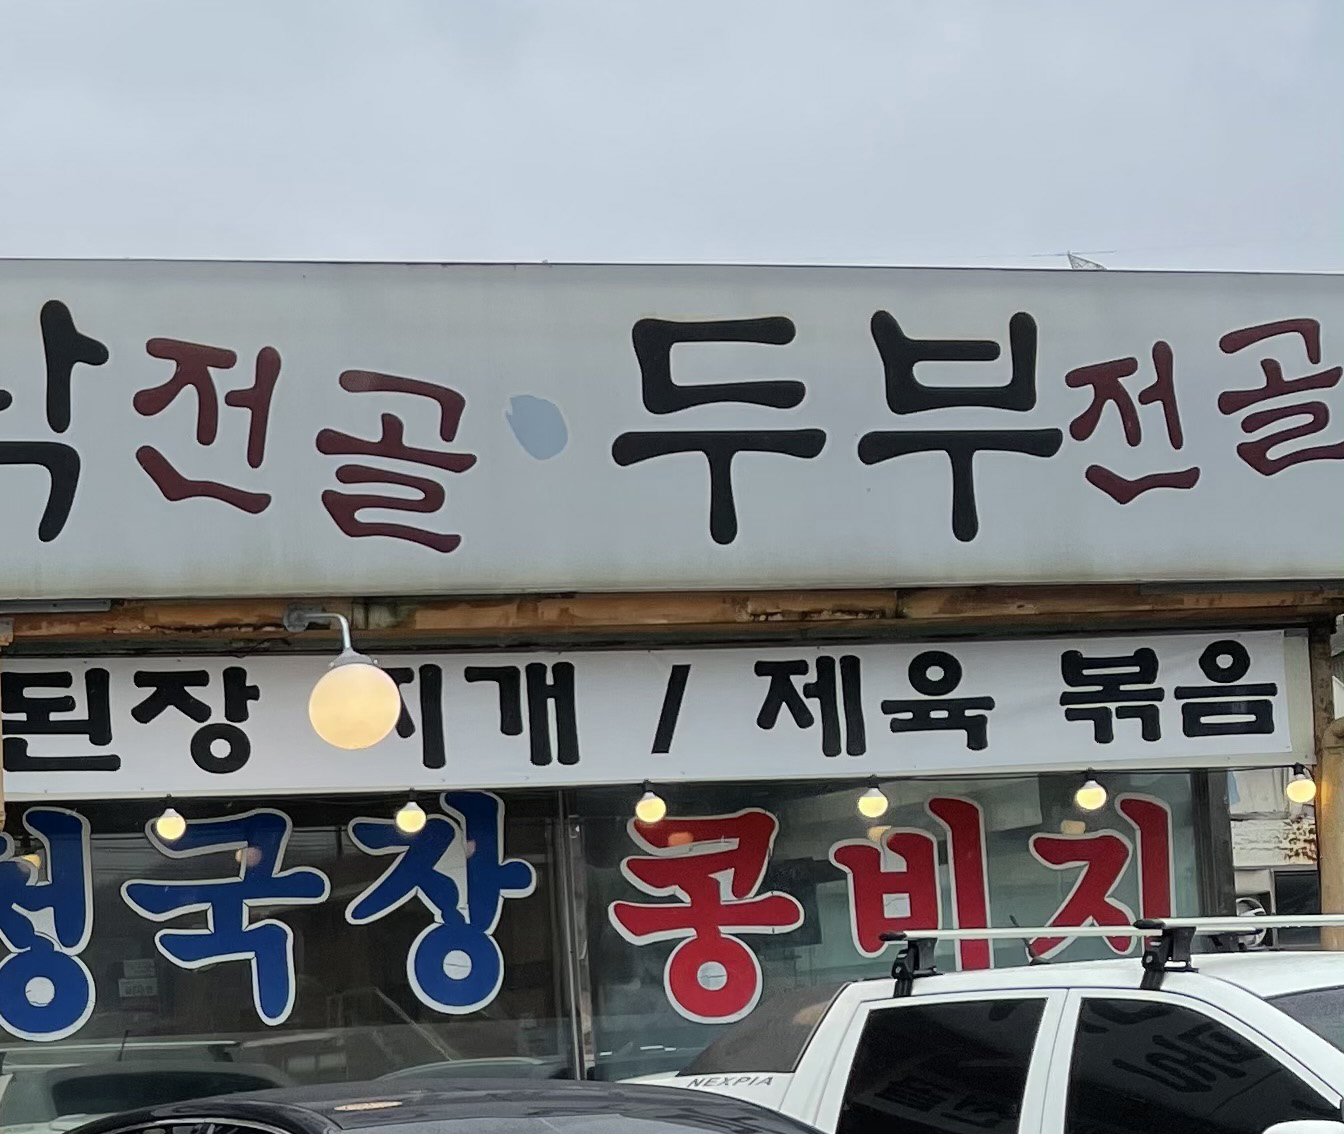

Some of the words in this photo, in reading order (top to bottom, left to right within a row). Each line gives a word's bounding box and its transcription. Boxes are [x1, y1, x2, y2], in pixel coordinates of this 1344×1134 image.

[0, 666, 260, 774] 된장
[754, 652, 995, 758] 제육
[1059, 640, 1277, 744] 볶음
[609, 795, 1178, 1024] 콩비지
[687, 1076, 774, 1088] NEXPIA
